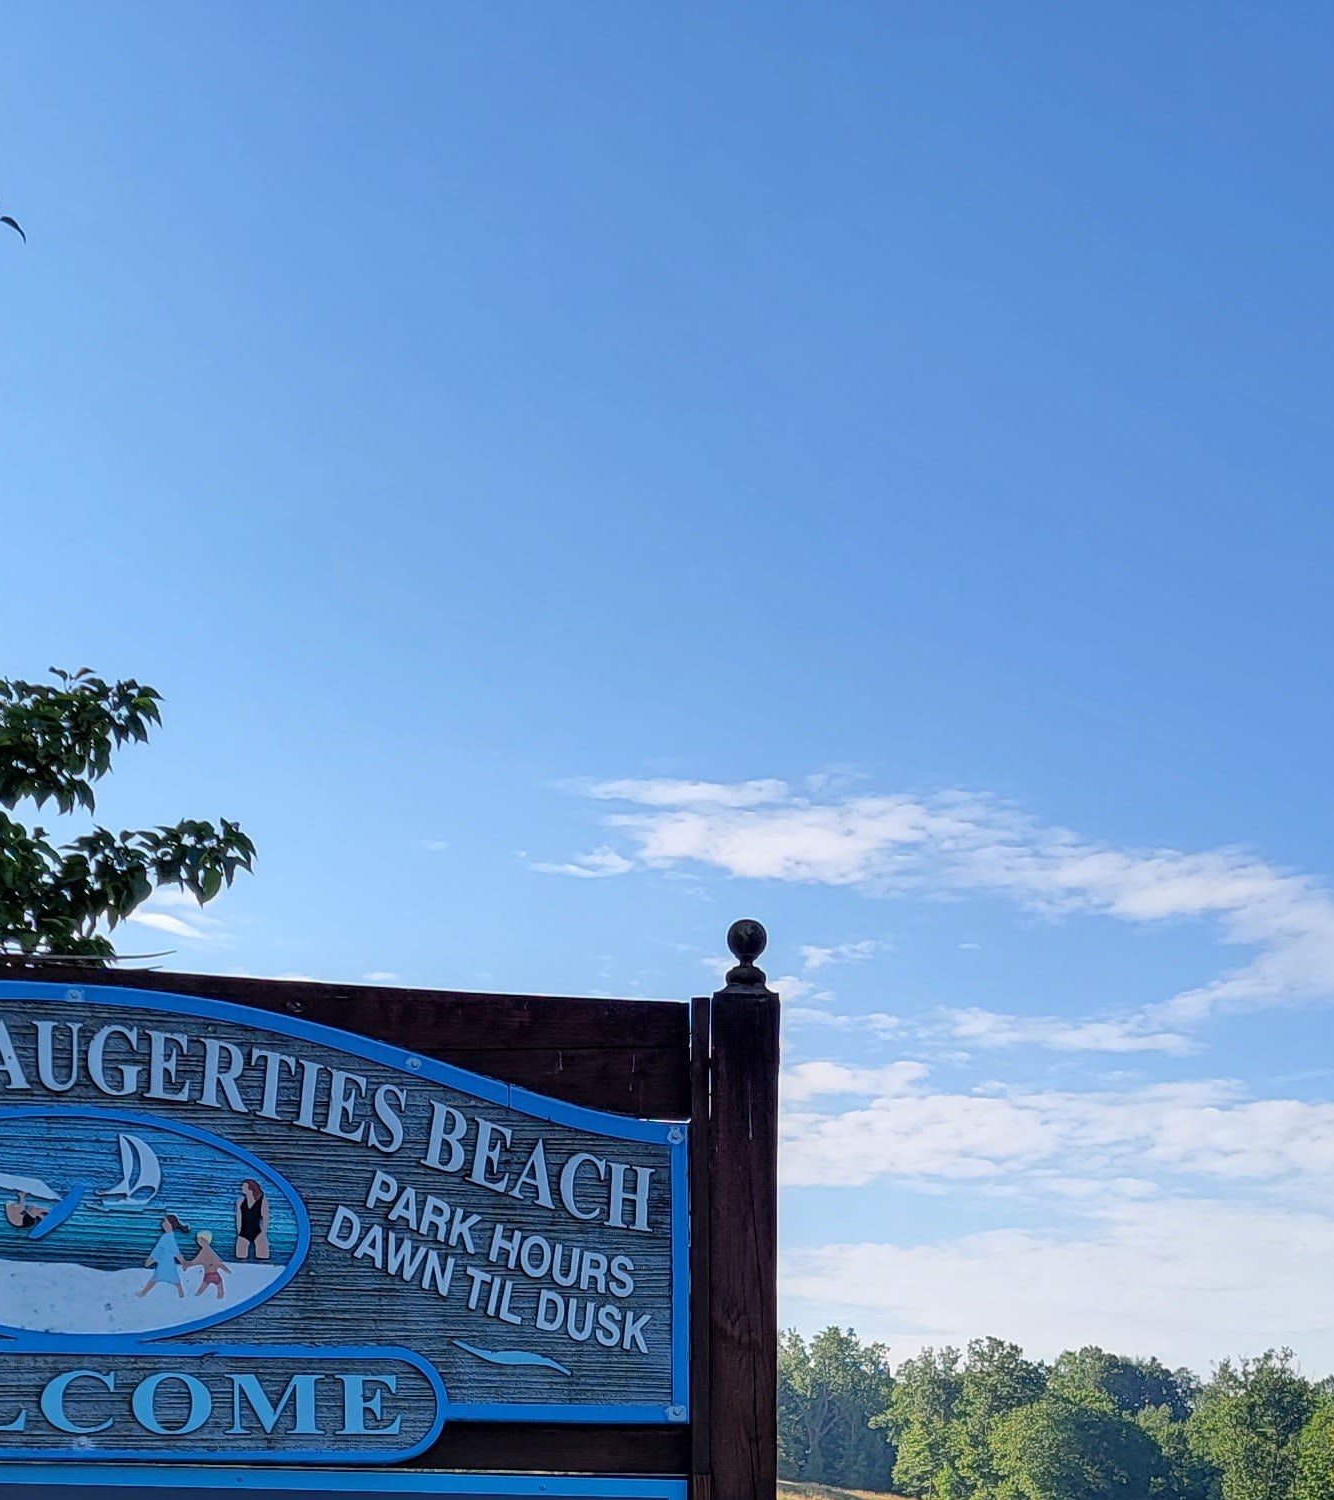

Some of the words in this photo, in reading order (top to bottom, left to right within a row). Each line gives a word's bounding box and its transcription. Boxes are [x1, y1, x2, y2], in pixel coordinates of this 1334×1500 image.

[419, 1100, 655, 1233] BEACH
[326, 1205, 457, 1299] DAWN
[466, 1266, 523, 1326] TIL
[534, 1288, 653, 1355] DUSK
[366, 1169, 483, 1255] PARK
[489, 1223, 636, 1299] HOURS
